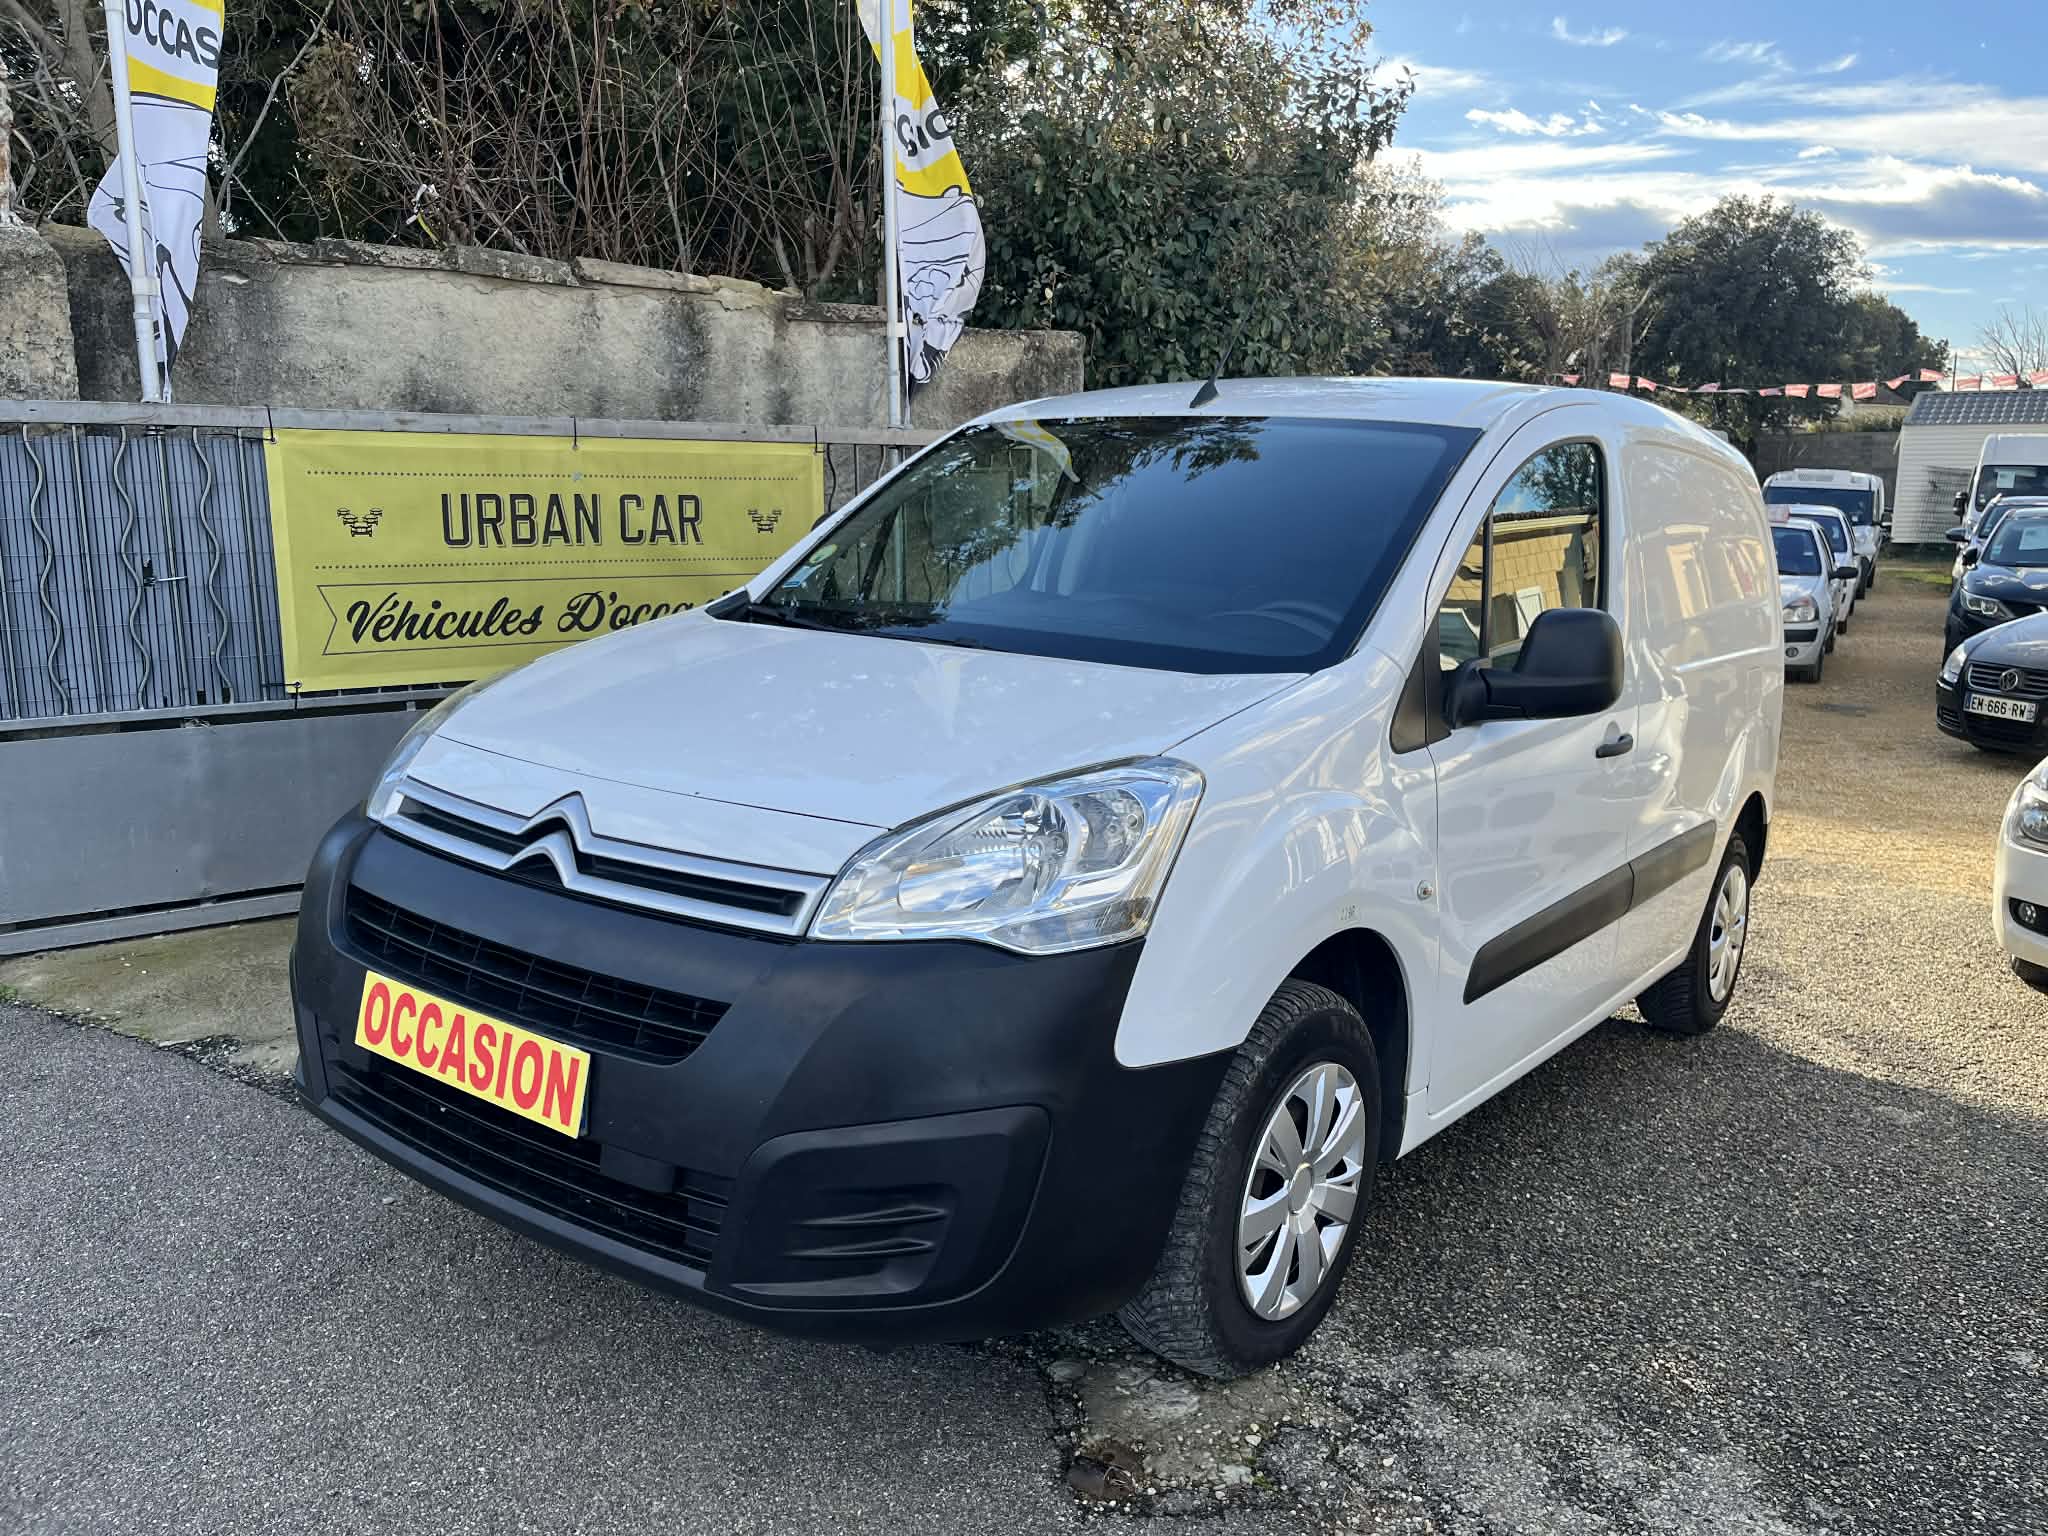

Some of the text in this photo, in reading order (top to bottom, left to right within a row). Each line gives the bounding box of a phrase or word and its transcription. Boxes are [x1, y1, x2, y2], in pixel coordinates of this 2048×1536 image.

[441, 493, 703, 547] URBAN CAR
[346, 592, 545, 644] Véhicules
[364, 982, 580, 1127] OCCASION
